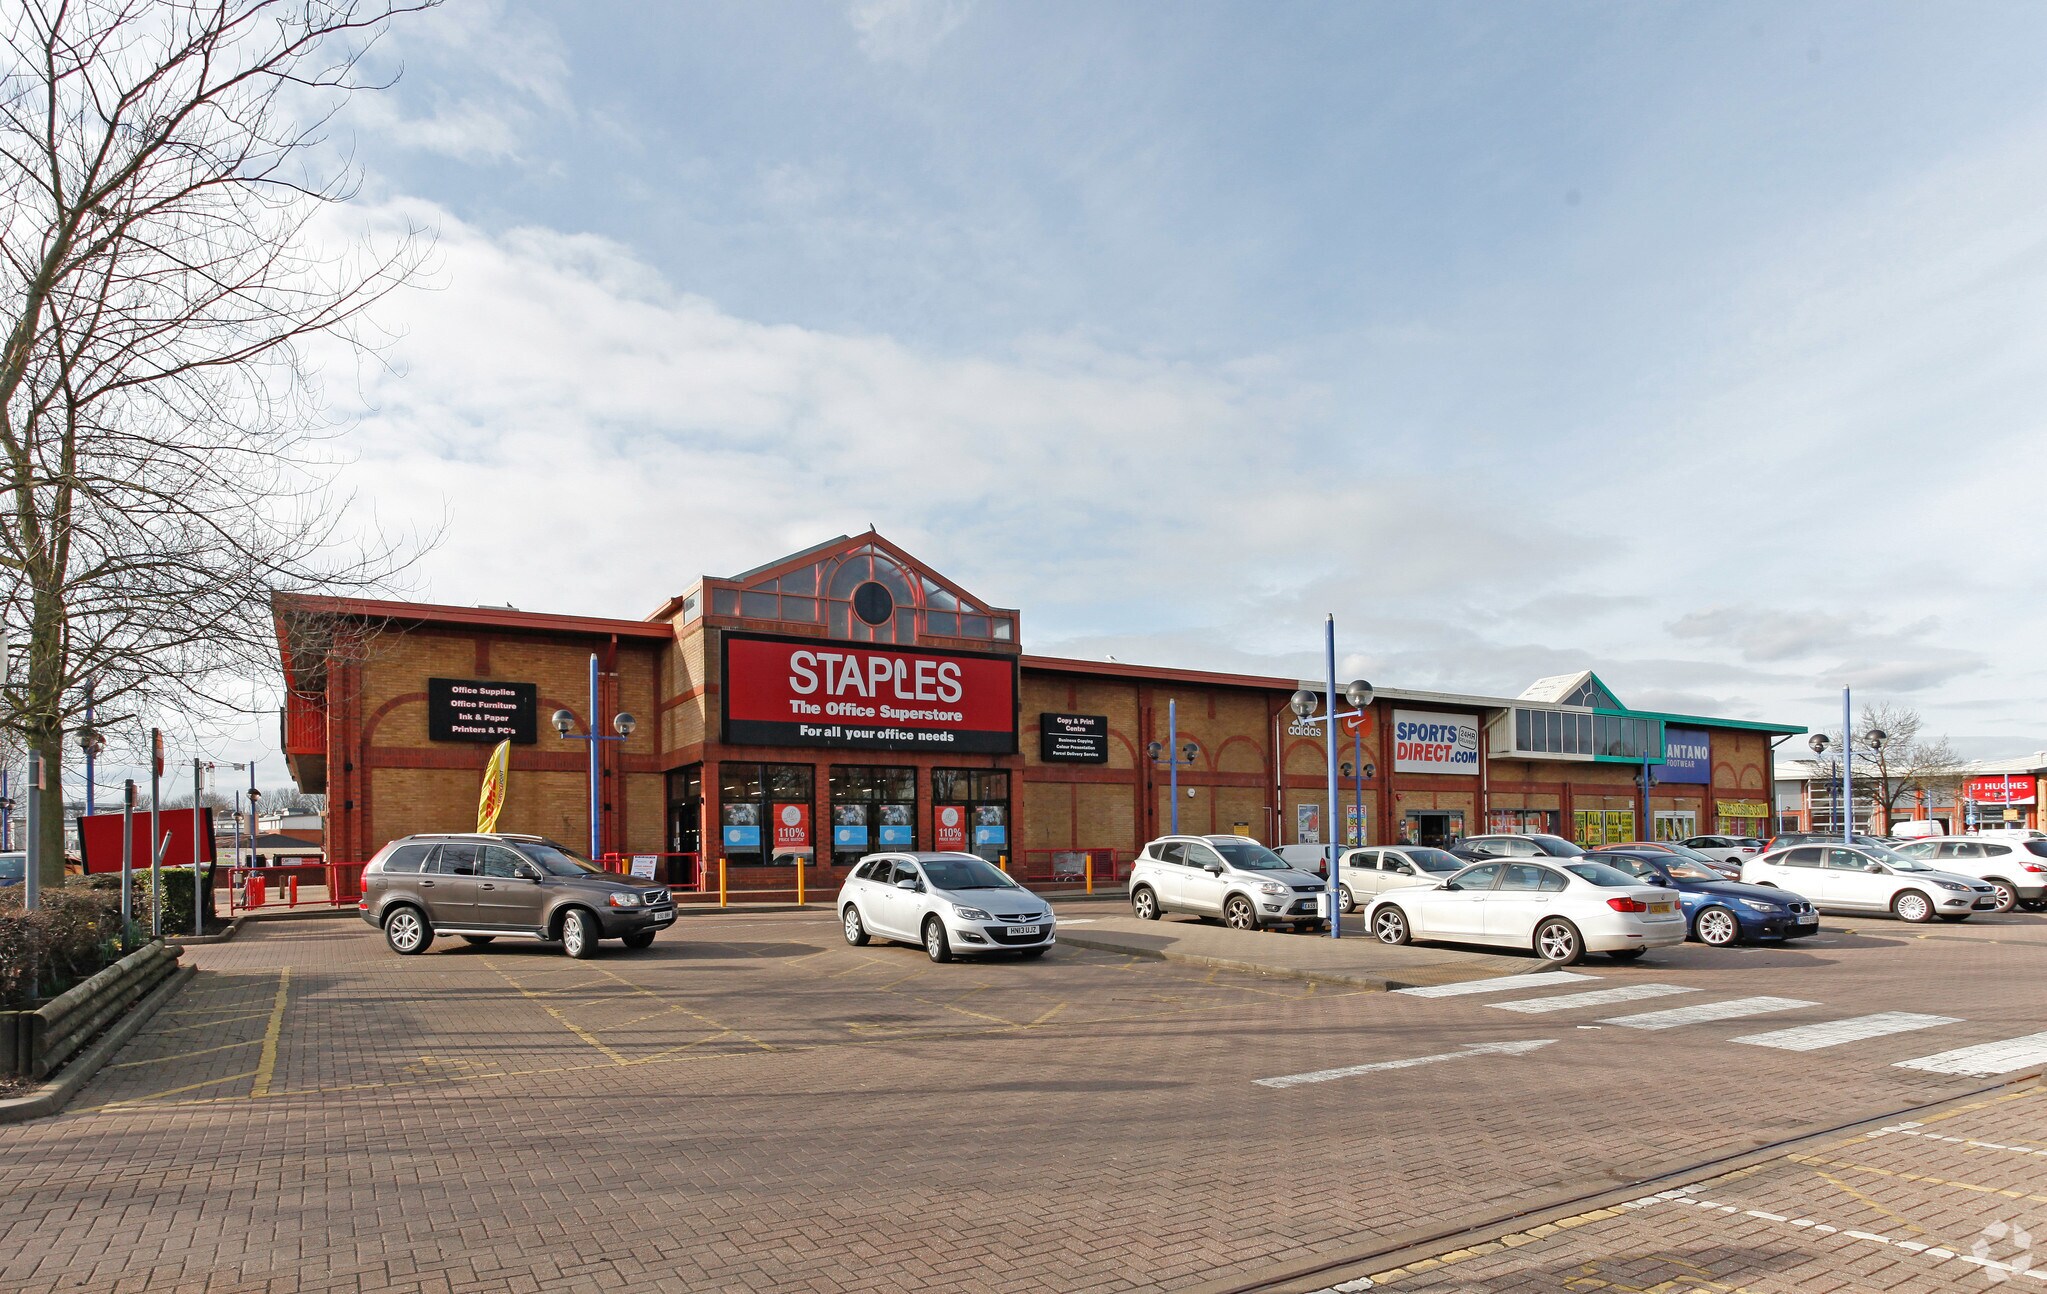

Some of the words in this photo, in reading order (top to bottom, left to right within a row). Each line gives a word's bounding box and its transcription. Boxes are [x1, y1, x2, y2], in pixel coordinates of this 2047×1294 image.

[789, 650, 963, 703] STAPLES
[452, 686, 477, 694] Office
[480, 687, 516, 696] Supplies
[450, 700, 477, 708] Office
[479, 701, 517, 709] Furniture
[789, 700, 821, 715] The
[826, 701, 875, 717] Office
[880, 704, 963, 722] Superstore
[484, 714, 509, 722] Paper
[1057, 717, 1072, 725] Copy
[452, 725, 486, 733] Printers
[800, 725, 822, 737] For
[824, 726, 841, 738] all
[845, 728, 875, 740] your
[877, 728, 914, 740] office
[918, 731, 954, 742] needs
[1287, 725, 1322, 736] adidas
[1397, 721, 1457, 743] SPORTS
[1460, 729, 1476, 740] 24HR
[1397, 742, 1477, 764] DIRECT.COM
[1665, 743, 1708, 760] ANTANO
[1667, 759, 1695, 768] FOOTWEAR
[1985, 782, 2028, 790] HUGHES
[1349, 807, 1366, 815] SAE
[778, 827, 805, 838] 110%
[938, 827, 962, 837] 110%
[1025, 926, 1037, 934] UJZ
